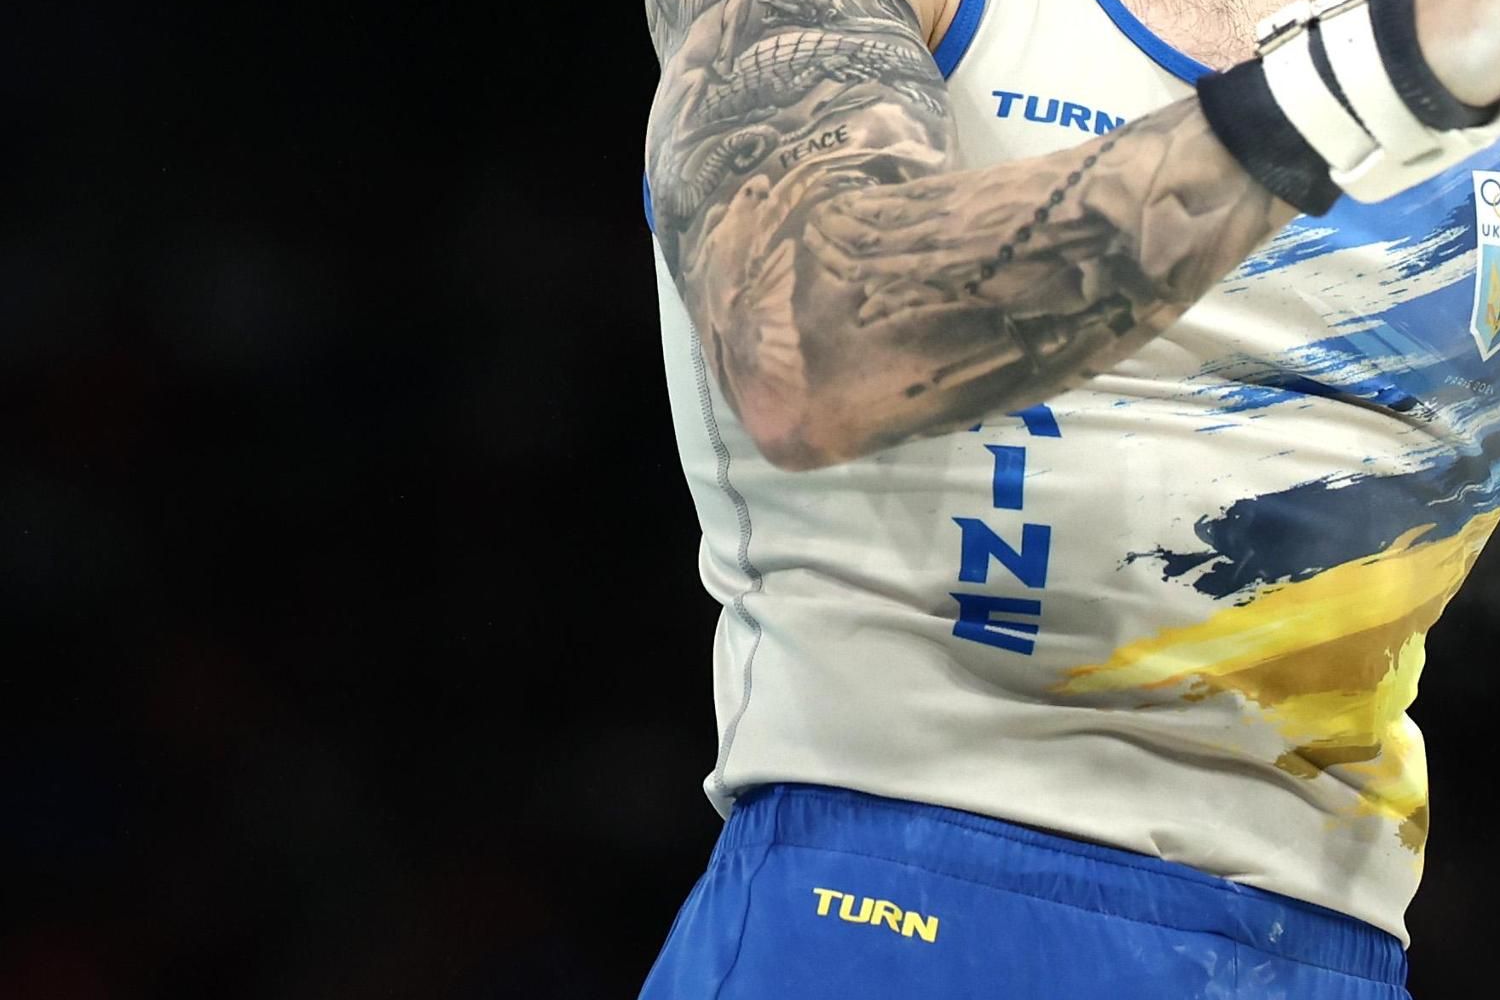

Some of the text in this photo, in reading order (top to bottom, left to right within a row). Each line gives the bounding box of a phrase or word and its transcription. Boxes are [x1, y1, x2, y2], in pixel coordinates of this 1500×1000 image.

[992, 90, 1126, 135] TURN
[780, 124, 848, 168] PEACE
[813, 888, 939, 943] TURN
